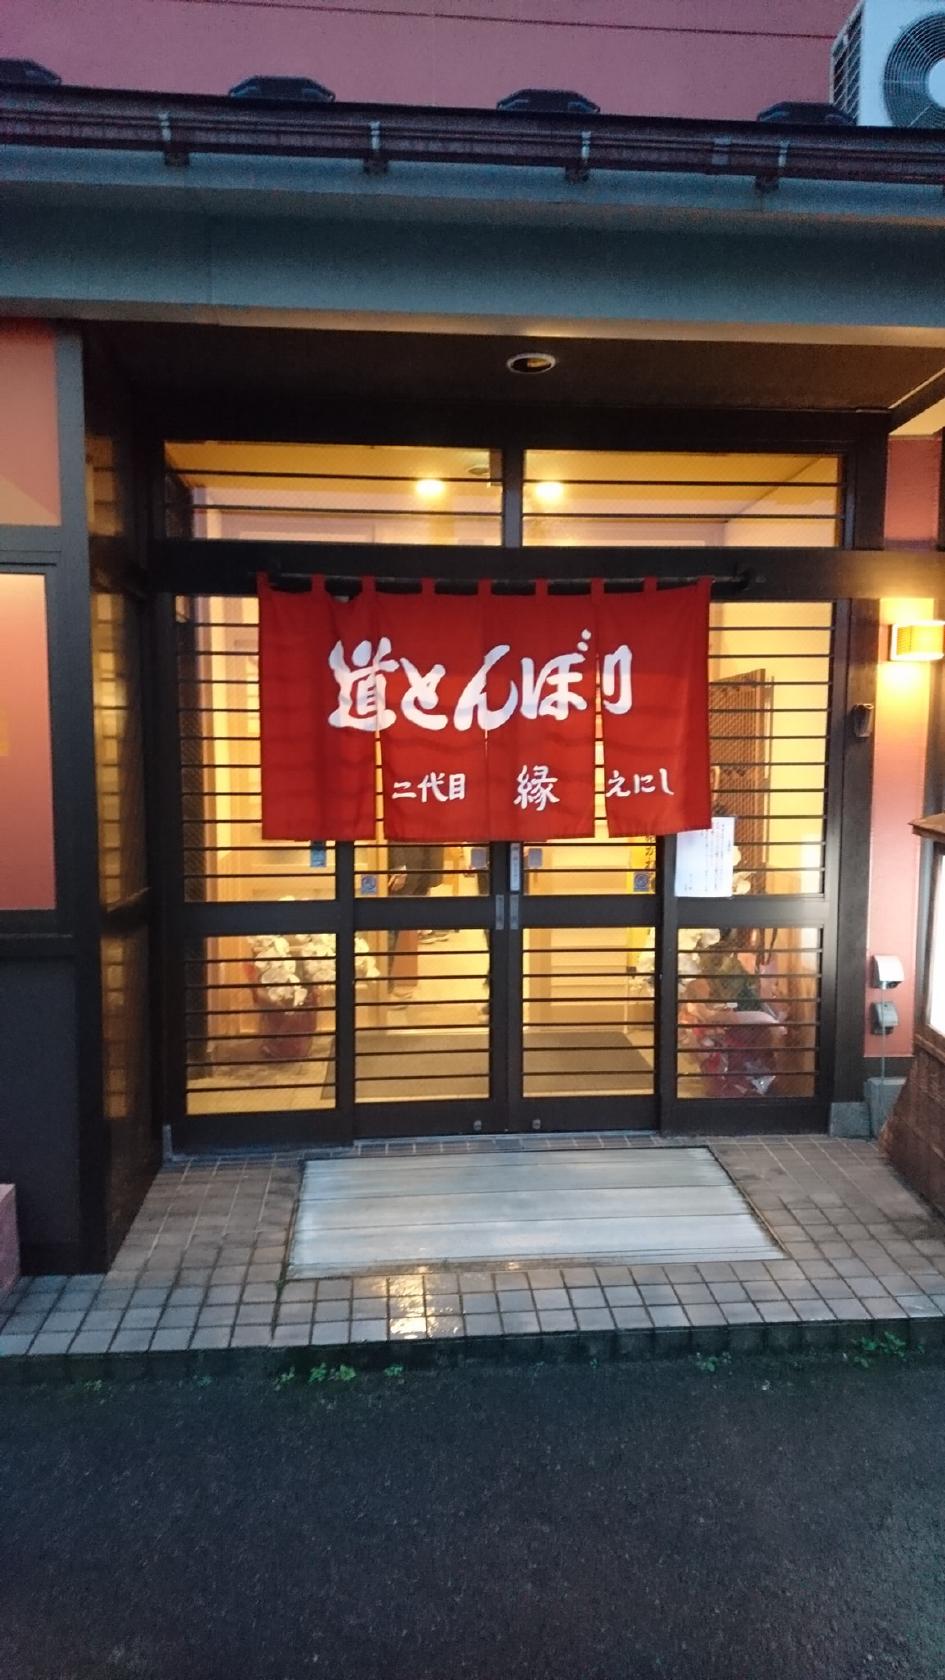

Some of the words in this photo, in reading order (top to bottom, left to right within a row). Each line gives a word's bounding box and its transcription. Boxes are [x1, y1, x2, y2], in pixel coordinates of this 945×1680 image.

[328, 629, 632, 731] 道とんぼり
[392, 772, 466, 802] 二代目
[513, 765, 560, 811] 縁
[606, 768, 674, 797] えにし
